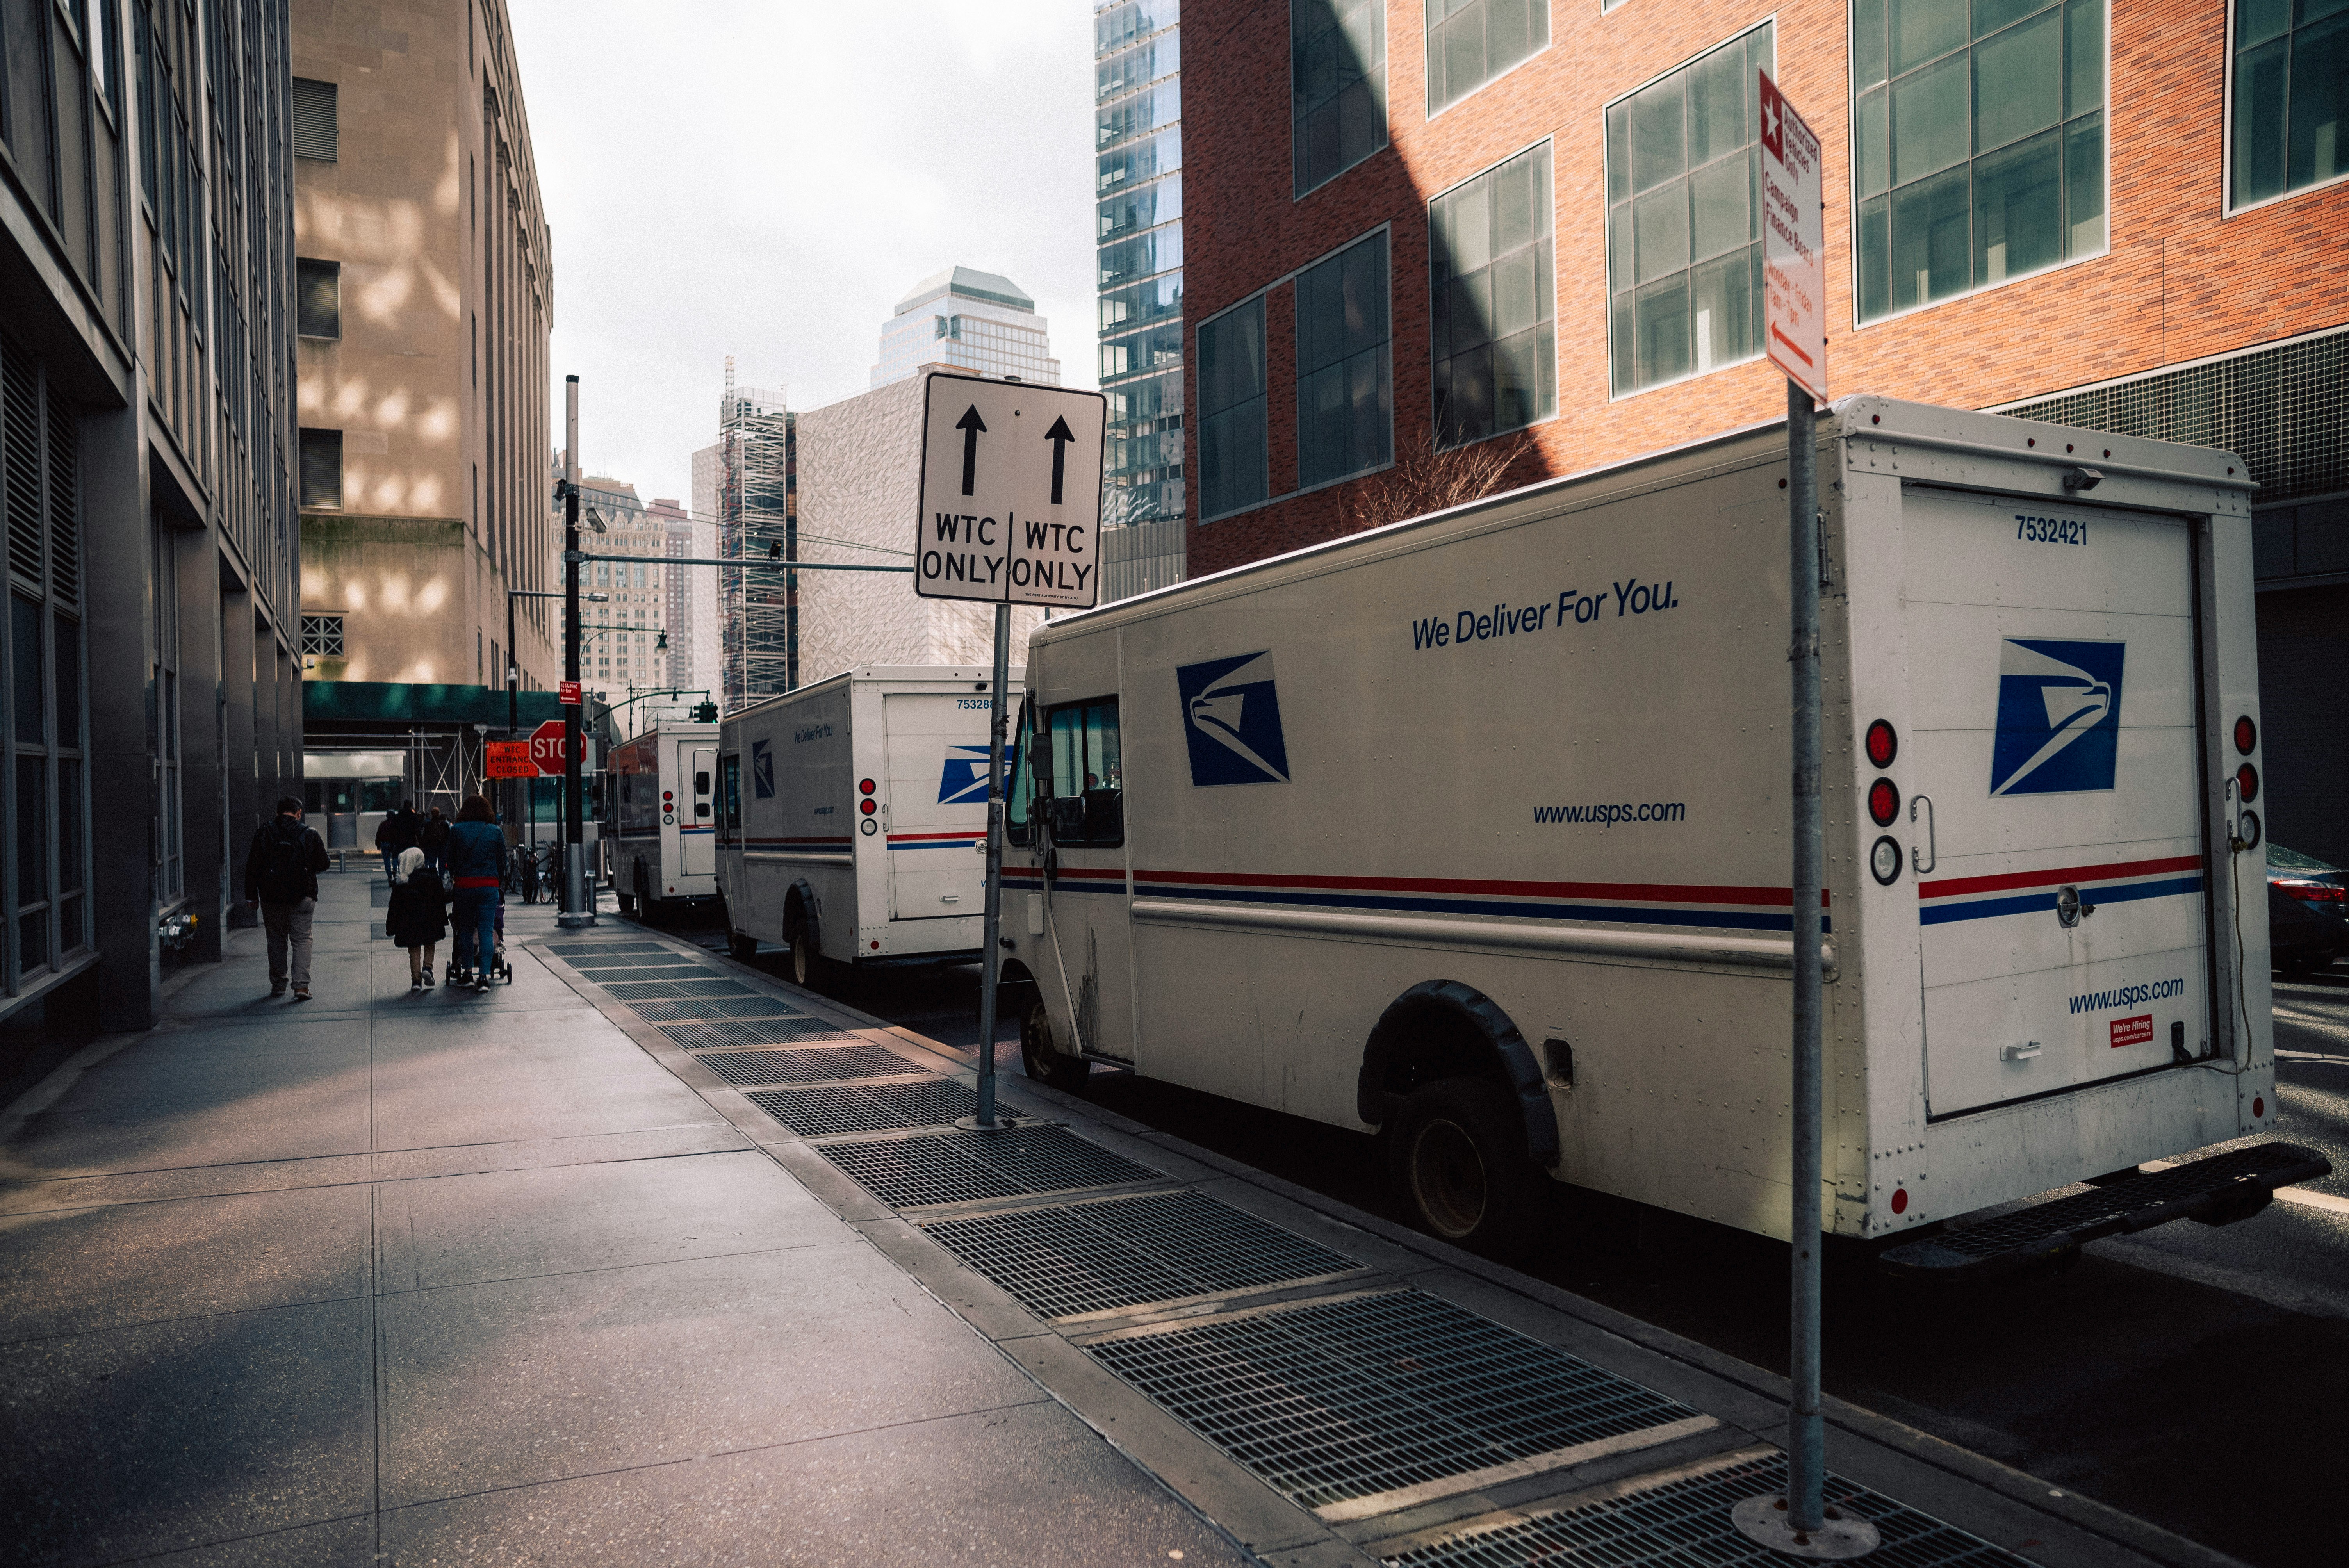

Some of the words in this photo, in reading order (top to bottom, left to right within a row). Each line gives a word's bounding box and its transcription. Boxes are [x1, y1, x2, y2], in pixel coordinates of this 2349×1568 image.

[1784, 108, 1817, 162] Authorized
[1784, 129, 1809, 174] Vehicles
[1785, 152, 1799, 187] Only
[1765, 170, 1798, 224] Campaign
[1766, 201, 1793, 246] Finance
[1794, 232, 1813, 267] Board
[936, 513, 996, 546] WTC
[1025, 521, 1085, 554] WTC
[2015, 515, 2087, 545] 7532421
[923, 551, 1005, 584] ONLY
[1012, 558, 1093, 591] ONLY
[1413, 617, 1449, 651] We
[1455, 602, 1551, 644] Deliver
[1556, 590, 1608, 627] For
[1613, 578, 1679, 617] You.
[504, 745, 520, 754] WTC
[534, 738, 583, 758] STO
[801, 728, 816, 742] Deliver
[1533, 802, 1685, 828] www.usps.com
[2069, 978, 2183, 1014] www.usps.com
[2113, 1023, 2131, 1034] We're
[2132, 1019, 2150, 1030] Hiring
[2113, 1031, 2151, 1043] usps.com/careers
